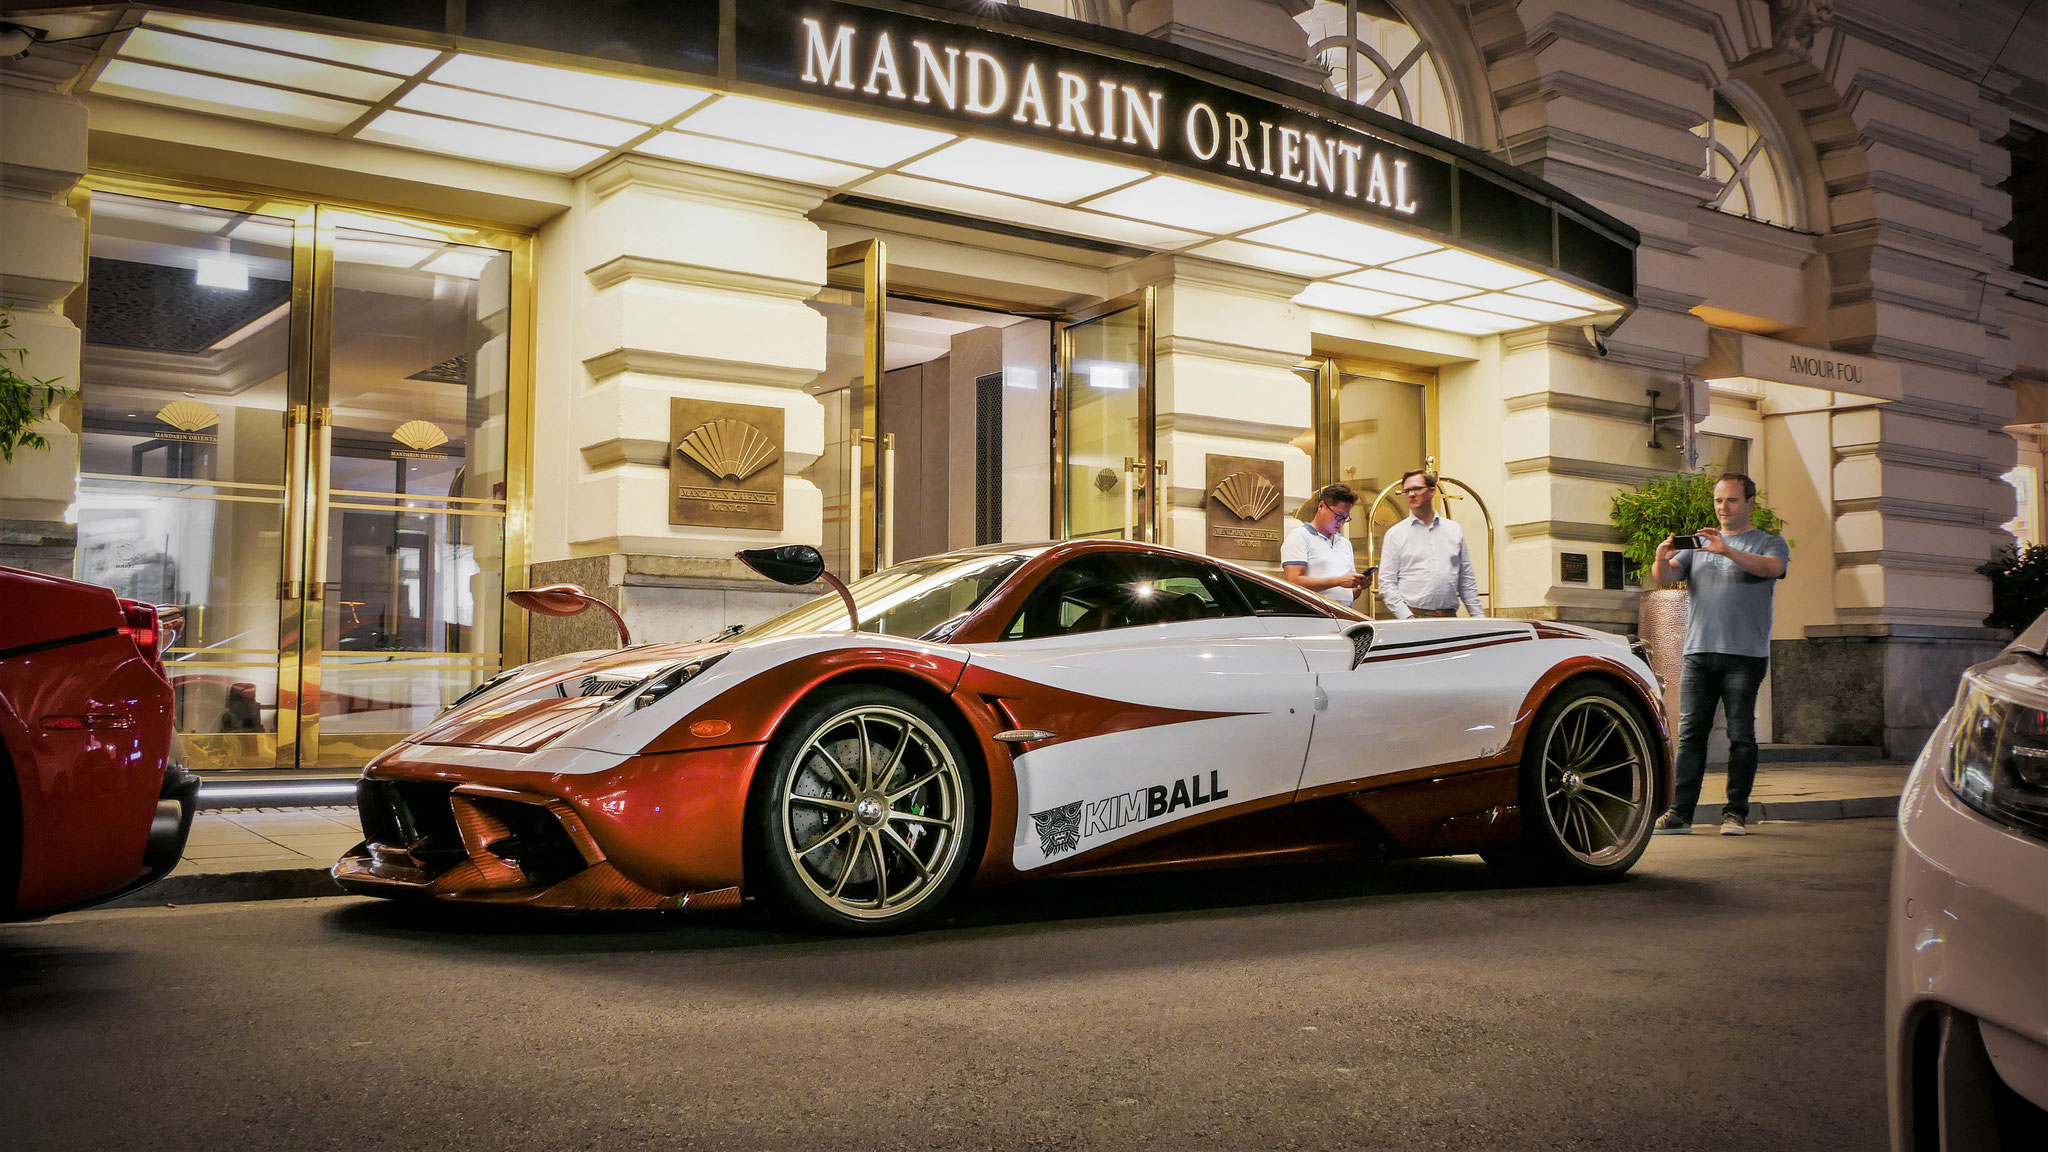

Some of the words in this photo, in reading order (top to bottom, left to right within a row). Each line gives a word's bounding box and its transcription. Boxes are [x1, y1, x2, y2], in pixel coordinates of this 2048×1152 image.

[801, 17, 1163, 151] MANDARIN
[1185, 102, 1417, 215] ORIENTAL
[1789, 354, 1835, 380] AMOUR
[1836, 362, 1863, 384] FOU
[154, 432, 187, 440] MANDARIN
[680, 487, 729, 500] MANDARIN
[731, 492, 776, 503] ORIENTAL
[709, 502, 748, 513] MUNICH
[1084, 769, 1229, 838] KIMBALL
